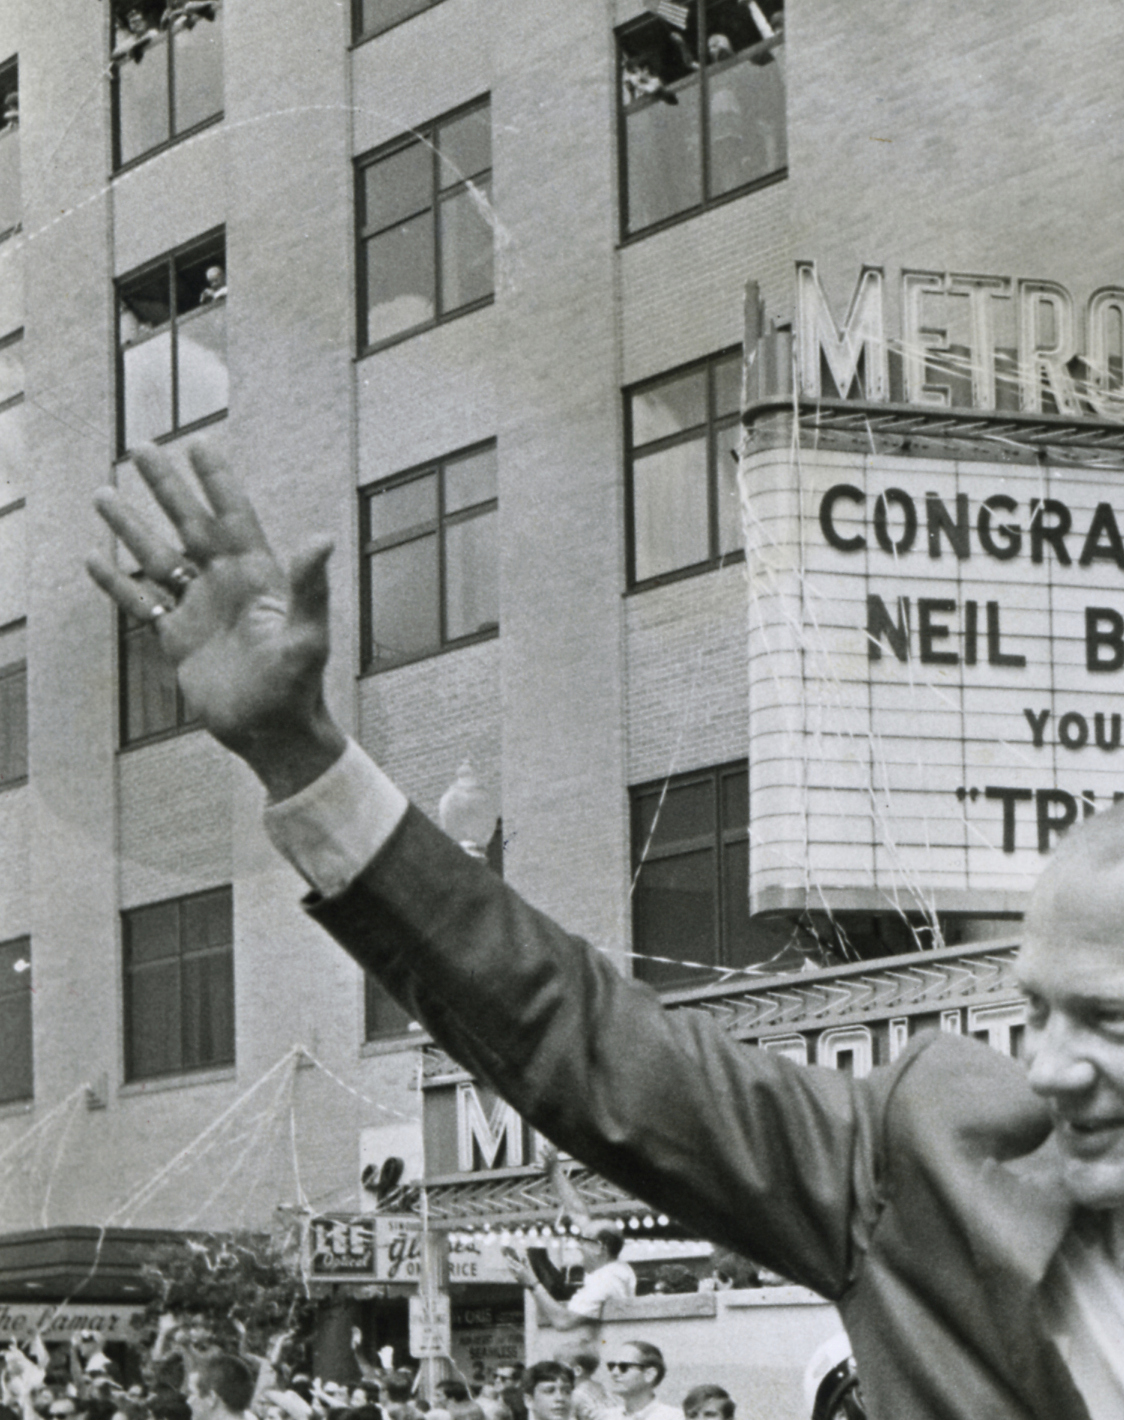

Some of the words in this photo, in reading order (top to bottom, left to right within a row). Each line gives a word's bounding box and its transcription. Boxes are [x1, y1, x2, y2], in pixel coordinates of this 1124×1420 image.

[866, 595, 1026, 668] NEIL
[1024, 709, 1122, 751] YOU
[313, 1224, 373, 1254] LEE
[449, 1261, 477, 1277] RICE
